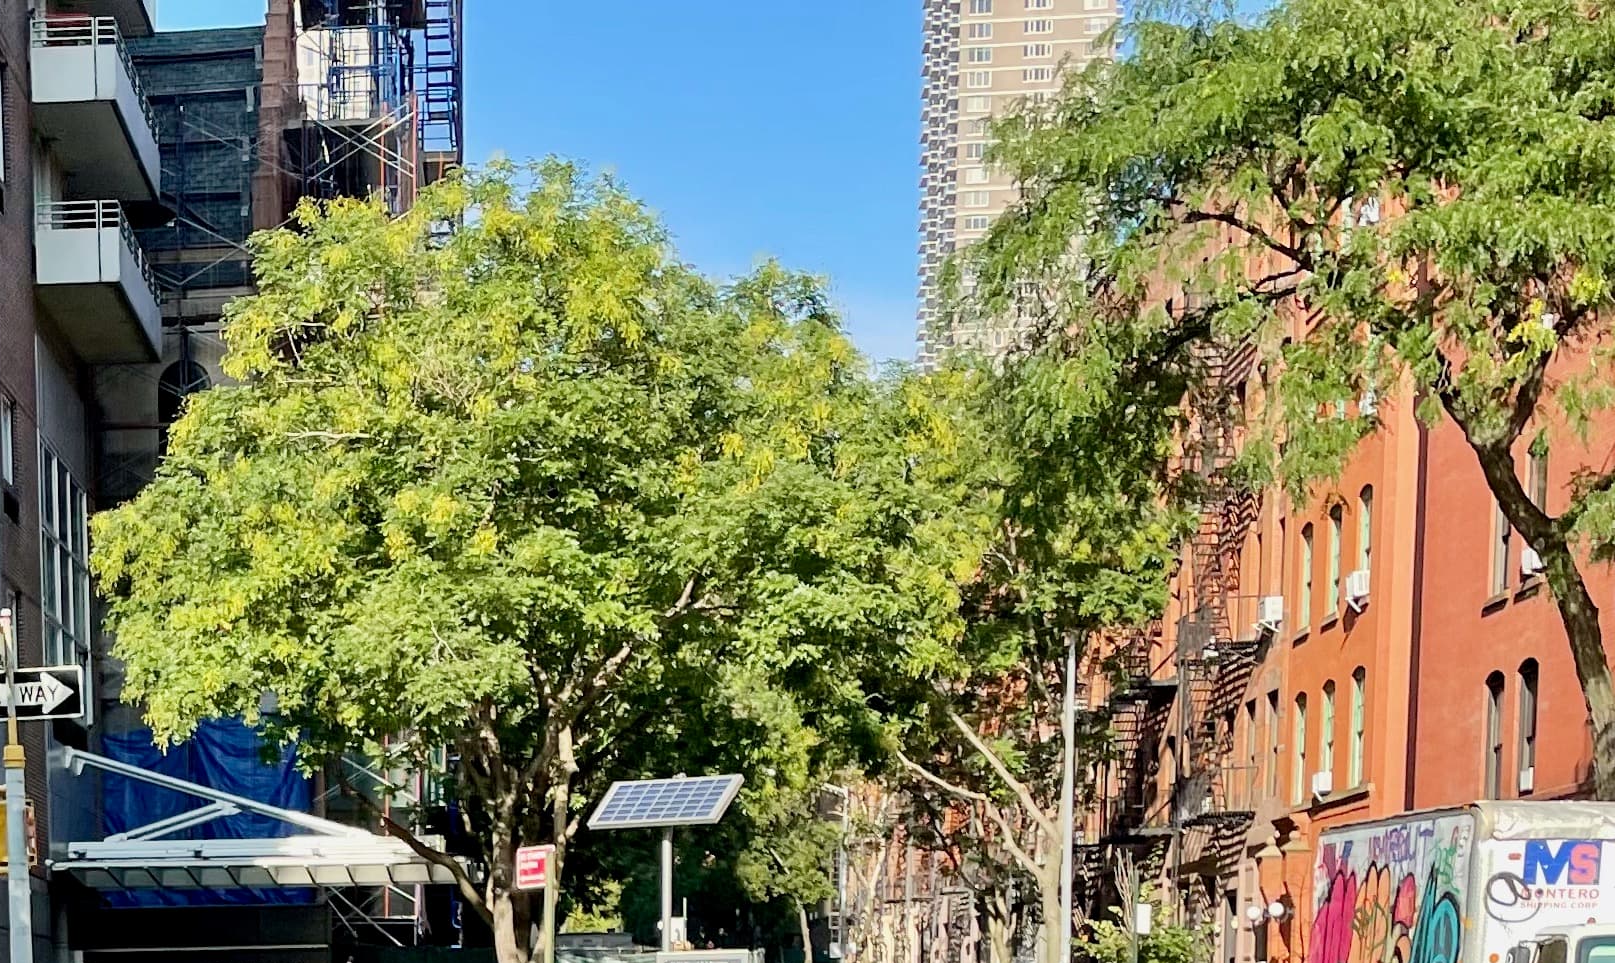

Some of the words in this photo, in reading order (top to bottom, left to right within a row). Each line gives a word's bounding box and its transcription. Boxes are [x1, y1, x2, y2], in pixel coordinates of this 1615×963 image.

[20, 685, 59, 703] WAY
[1523, 839, 1602, 885] MS
[1521, 888, 1600, 900] NTERO
